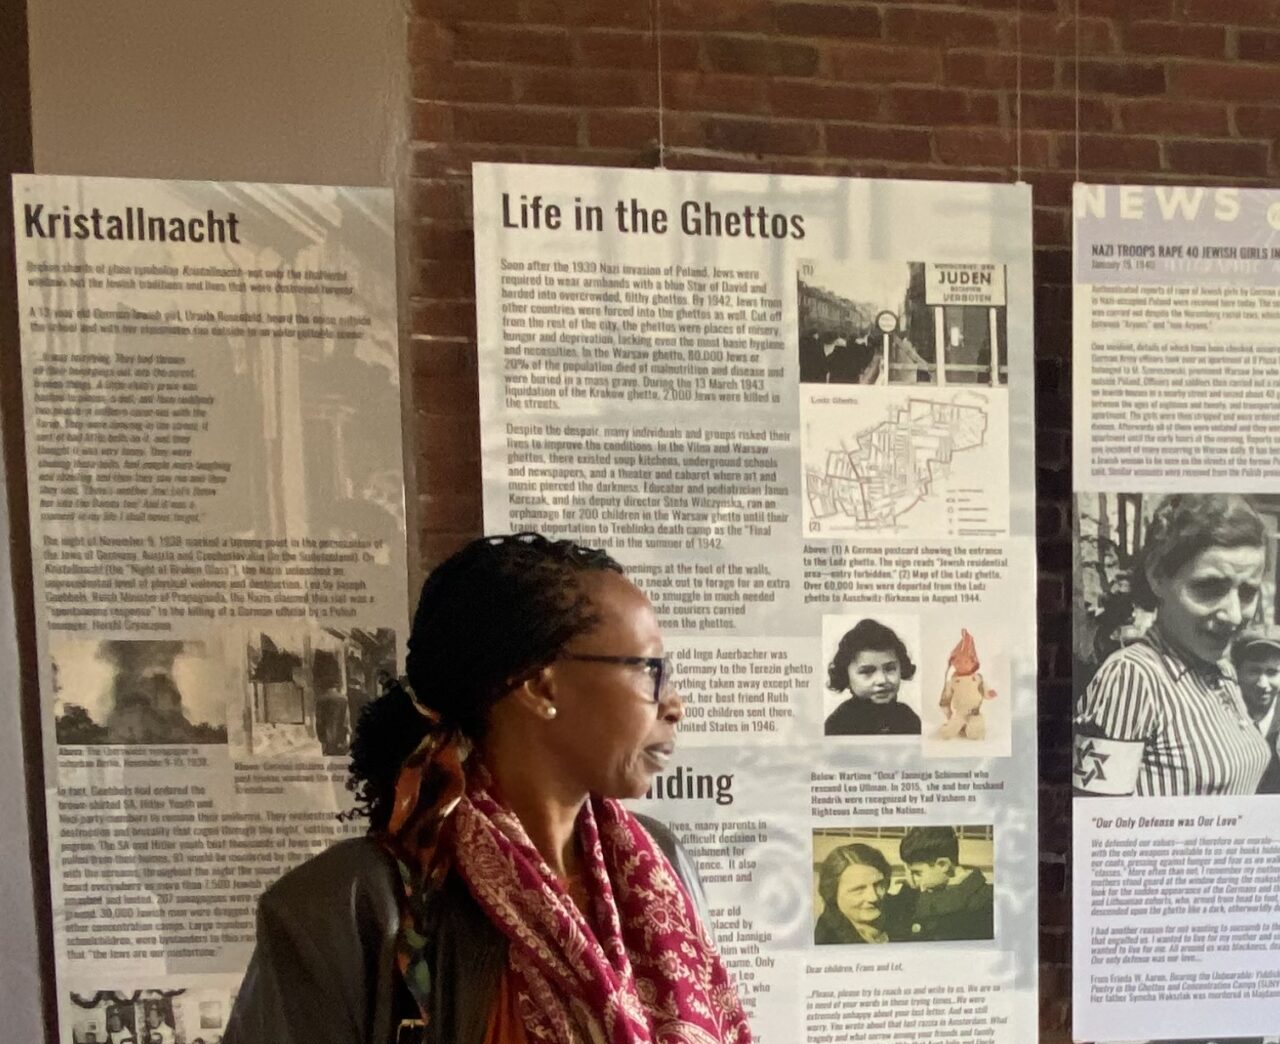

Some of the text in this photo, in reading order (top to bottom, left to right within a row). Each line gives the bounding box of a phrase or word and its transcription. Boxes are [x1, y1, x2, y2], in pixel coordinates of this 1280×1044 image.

[1076, 187, 1240, 222] NEWS
[502, 193, 806, 240] Life in the Ghettos
[24, 204, 240, 245] Kristallnacht
[1092, 245, 1113, 256] NAZI
[1118, 246, 1155, 257] TROOPS
[1158, 246, 1182, 257] RAPE
[1186, 247, 1199, 258] 40
[1202, 247, 1236, 258] JEWISH
[1240, 248, 1268, 259] GIRLS
[1271, 248, 1280, 259] IN
[501, 260, 759, 278] Soon after the 1939 Nazi invasion of Jews were
[938, 271, 991, 285] JUDEN
[943, 294, 991, 303] VERBOTEN
[505, 359, 784, 377] 20% of the population died of malnutrition and disease and
[809, 522, 821, 532] (2)
[665, 565, 674, 573] at
[678, 565, 692, 573] the
[695, 565, 713, 573] foot
[717, 565, 726, 573] of
[729, 565, 743, 574] the
[804, 582, 821, 590] Over
[825, 582, 853, 592] 60,000
[856, 582, 873, 590] Jews
[897, 582, 931, 592] deported
[934, 582, 951, 590] from
[955, 582, 966, 590] the
[932, 594, 957, 604] August
[677, 650, 690, 659] old
[716, 650, 768, 659] Auerbacher
[677, 664, 813, 676] Germany to the Terezin ghetto
[710, 678, 809, 690] taken away except her
[698, 692, 789, 702] her best friend Ruth
[708, 707, 744, 717] children
[747, 707, 765, 717] sent
[677, 722, 778, 731] United States in 1946.
[646, 767, 734, 805] iding
[811, 784, 841, 792] rescued
[891, 783, 898, 791] In
[927, 782, 939, 790] she
[942, 782, 955, 790] and
[958, 782, 970, 790] her
[973, 781, 1003, 790] husband
[695, 823, 718, 832] many
[722, 821, 756, 832] parents
[759, 821, 766, 829] in
[1116, 818, 1135, 830] Only
[1139, 817, 1174, 827] Defense
[1197, 816, 1213, 826] Our
